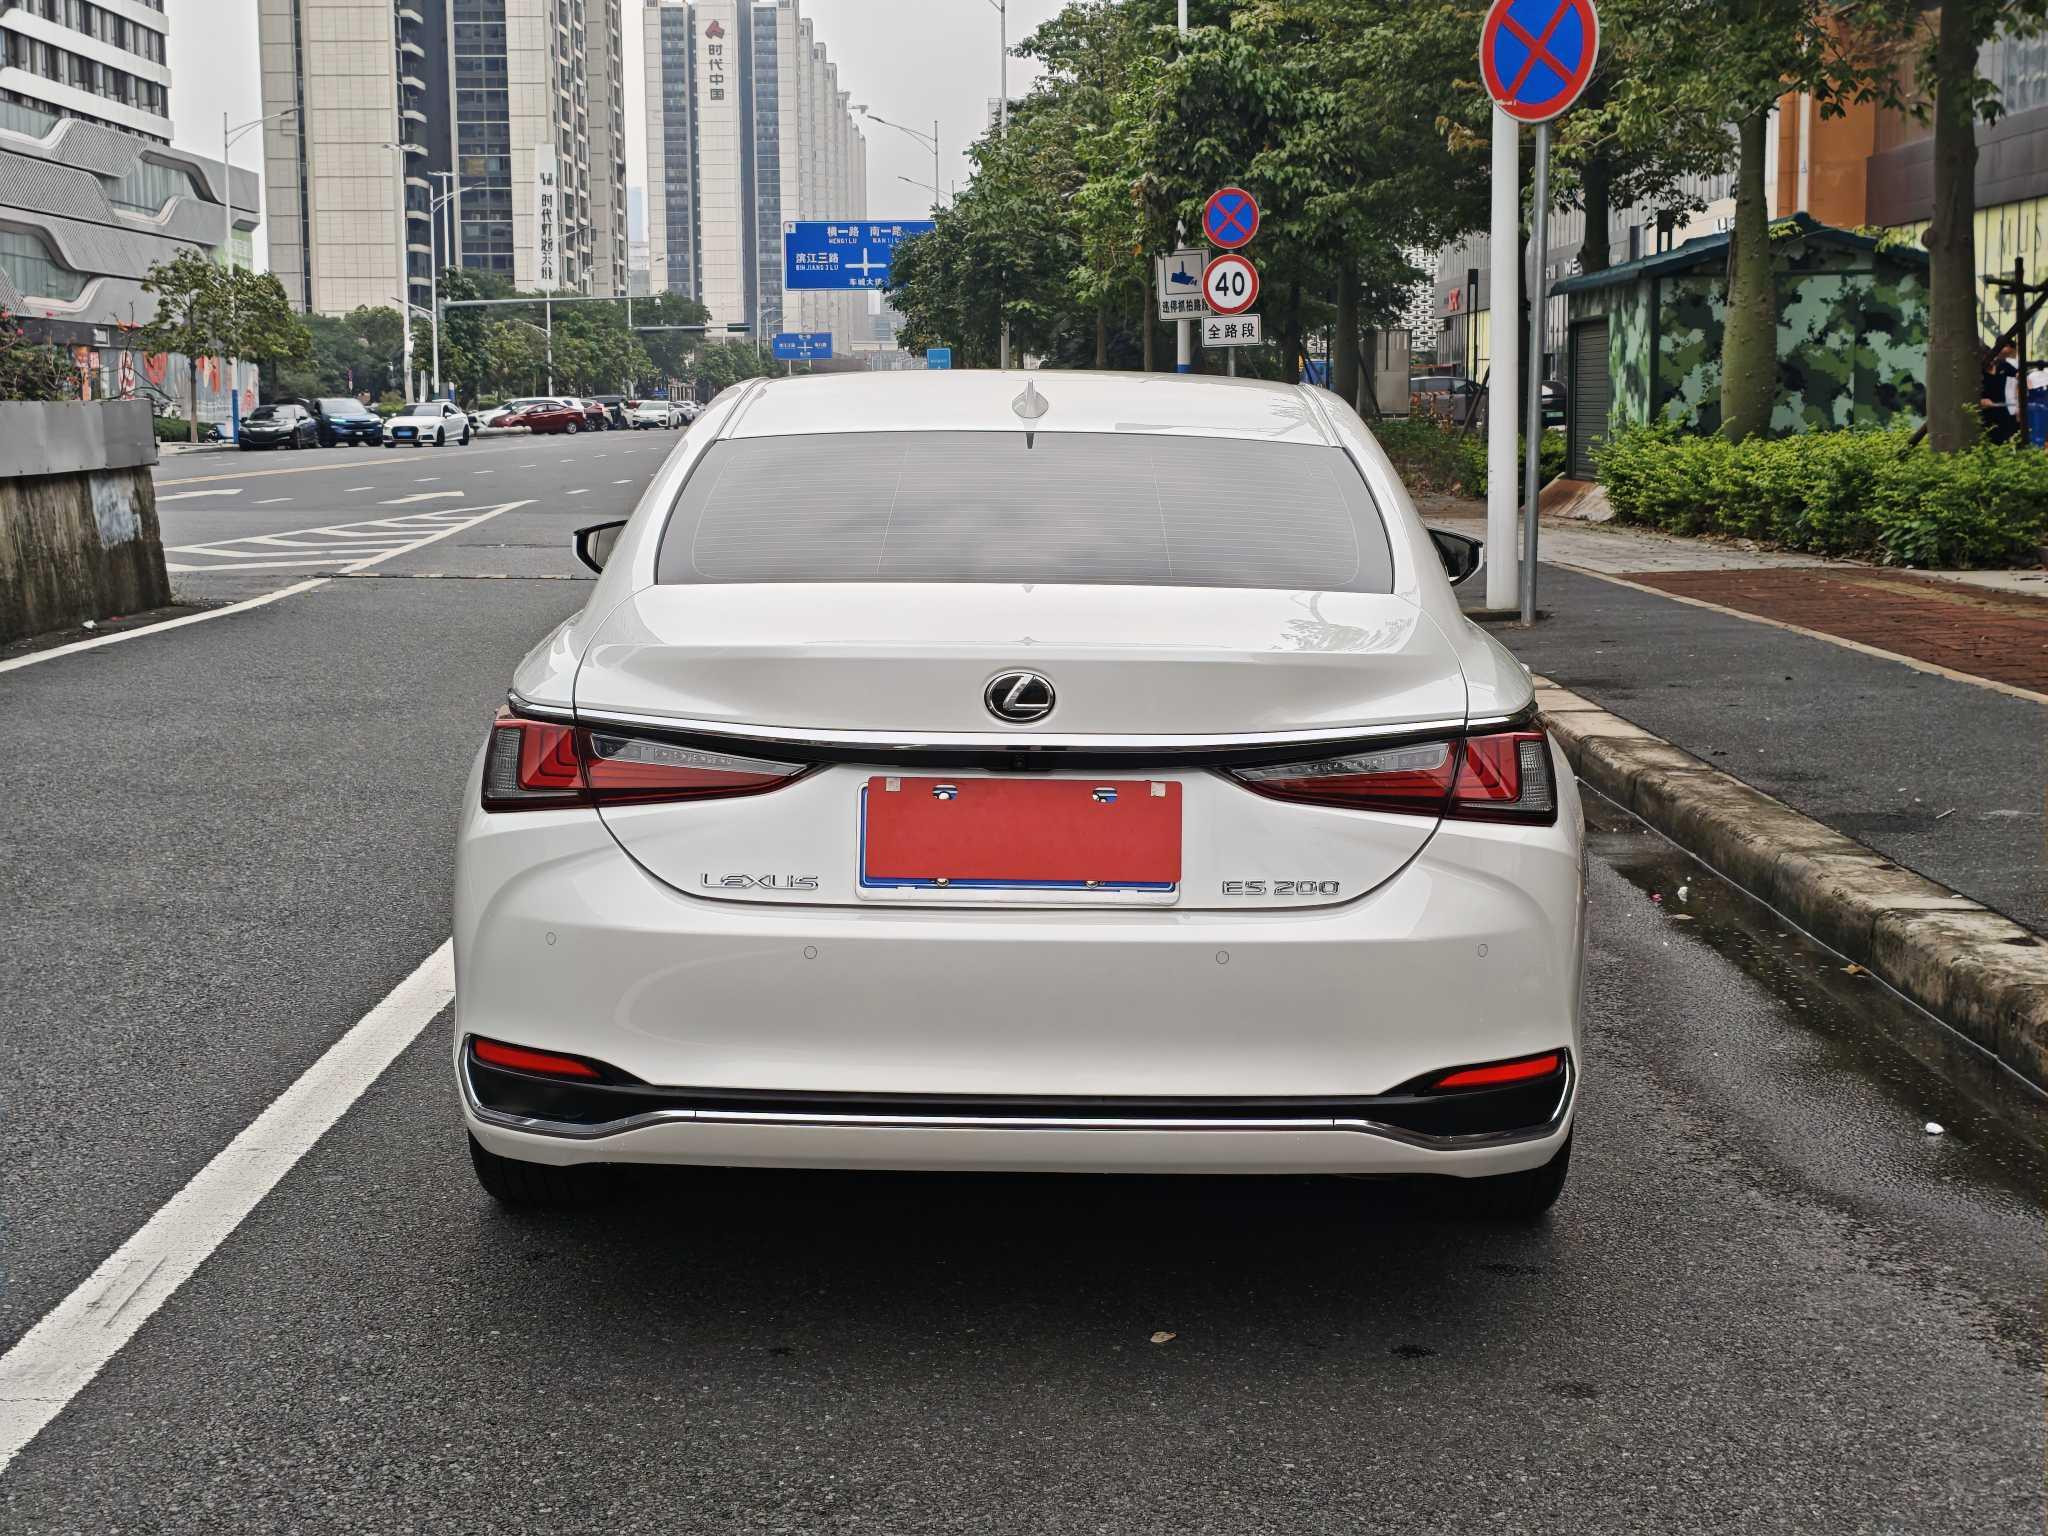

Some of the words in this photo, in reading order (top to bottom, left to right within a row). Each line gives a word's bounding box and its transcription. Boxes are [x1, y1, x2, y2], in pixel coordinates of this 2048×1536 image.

[708, 44, 724, 100] 时代中国
[827, 226, 859, 237] 横一路
[795, 252, 839, 264] 滨江三路
[1215, 271, 1245, 297] 40
[1208, 323, 1256, 340] 全路段
[700, 873, 819, 890] LEXUS
[1222, 880, 1267, 896] ES
[1273, 880, 1340, 896] 200
